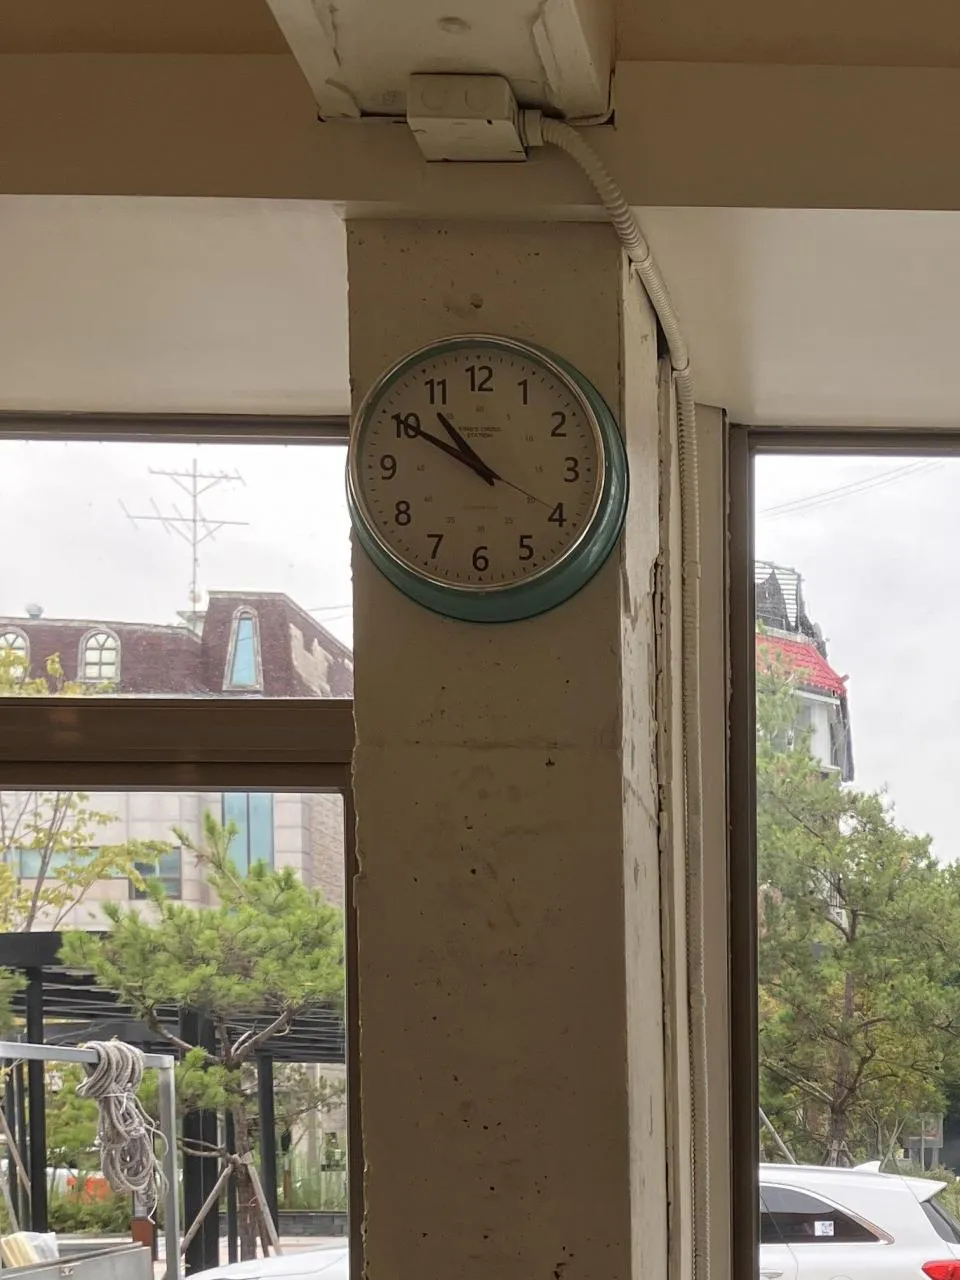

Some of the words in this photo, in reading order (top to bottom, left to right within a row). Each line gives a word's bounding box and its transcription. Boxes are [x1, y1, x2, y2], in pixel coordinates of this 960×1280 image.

[465, 365, 494, 392] 12
[424, 379, 447, 405] 11
[517, 379, 529, 405] 1
[391, 412, 421, 439] 10
[550, 411, 567, 438] 2
[380, 454, 397, 480] 9
[563, 457, 580, 483] 3
[394, 501, 411, 526] 8
[547, 502, 566, 528] 4
[427, 534, 444, 559] 7
[472, 546, 489, 572] 6
[518, 535, 534, 561] 5
